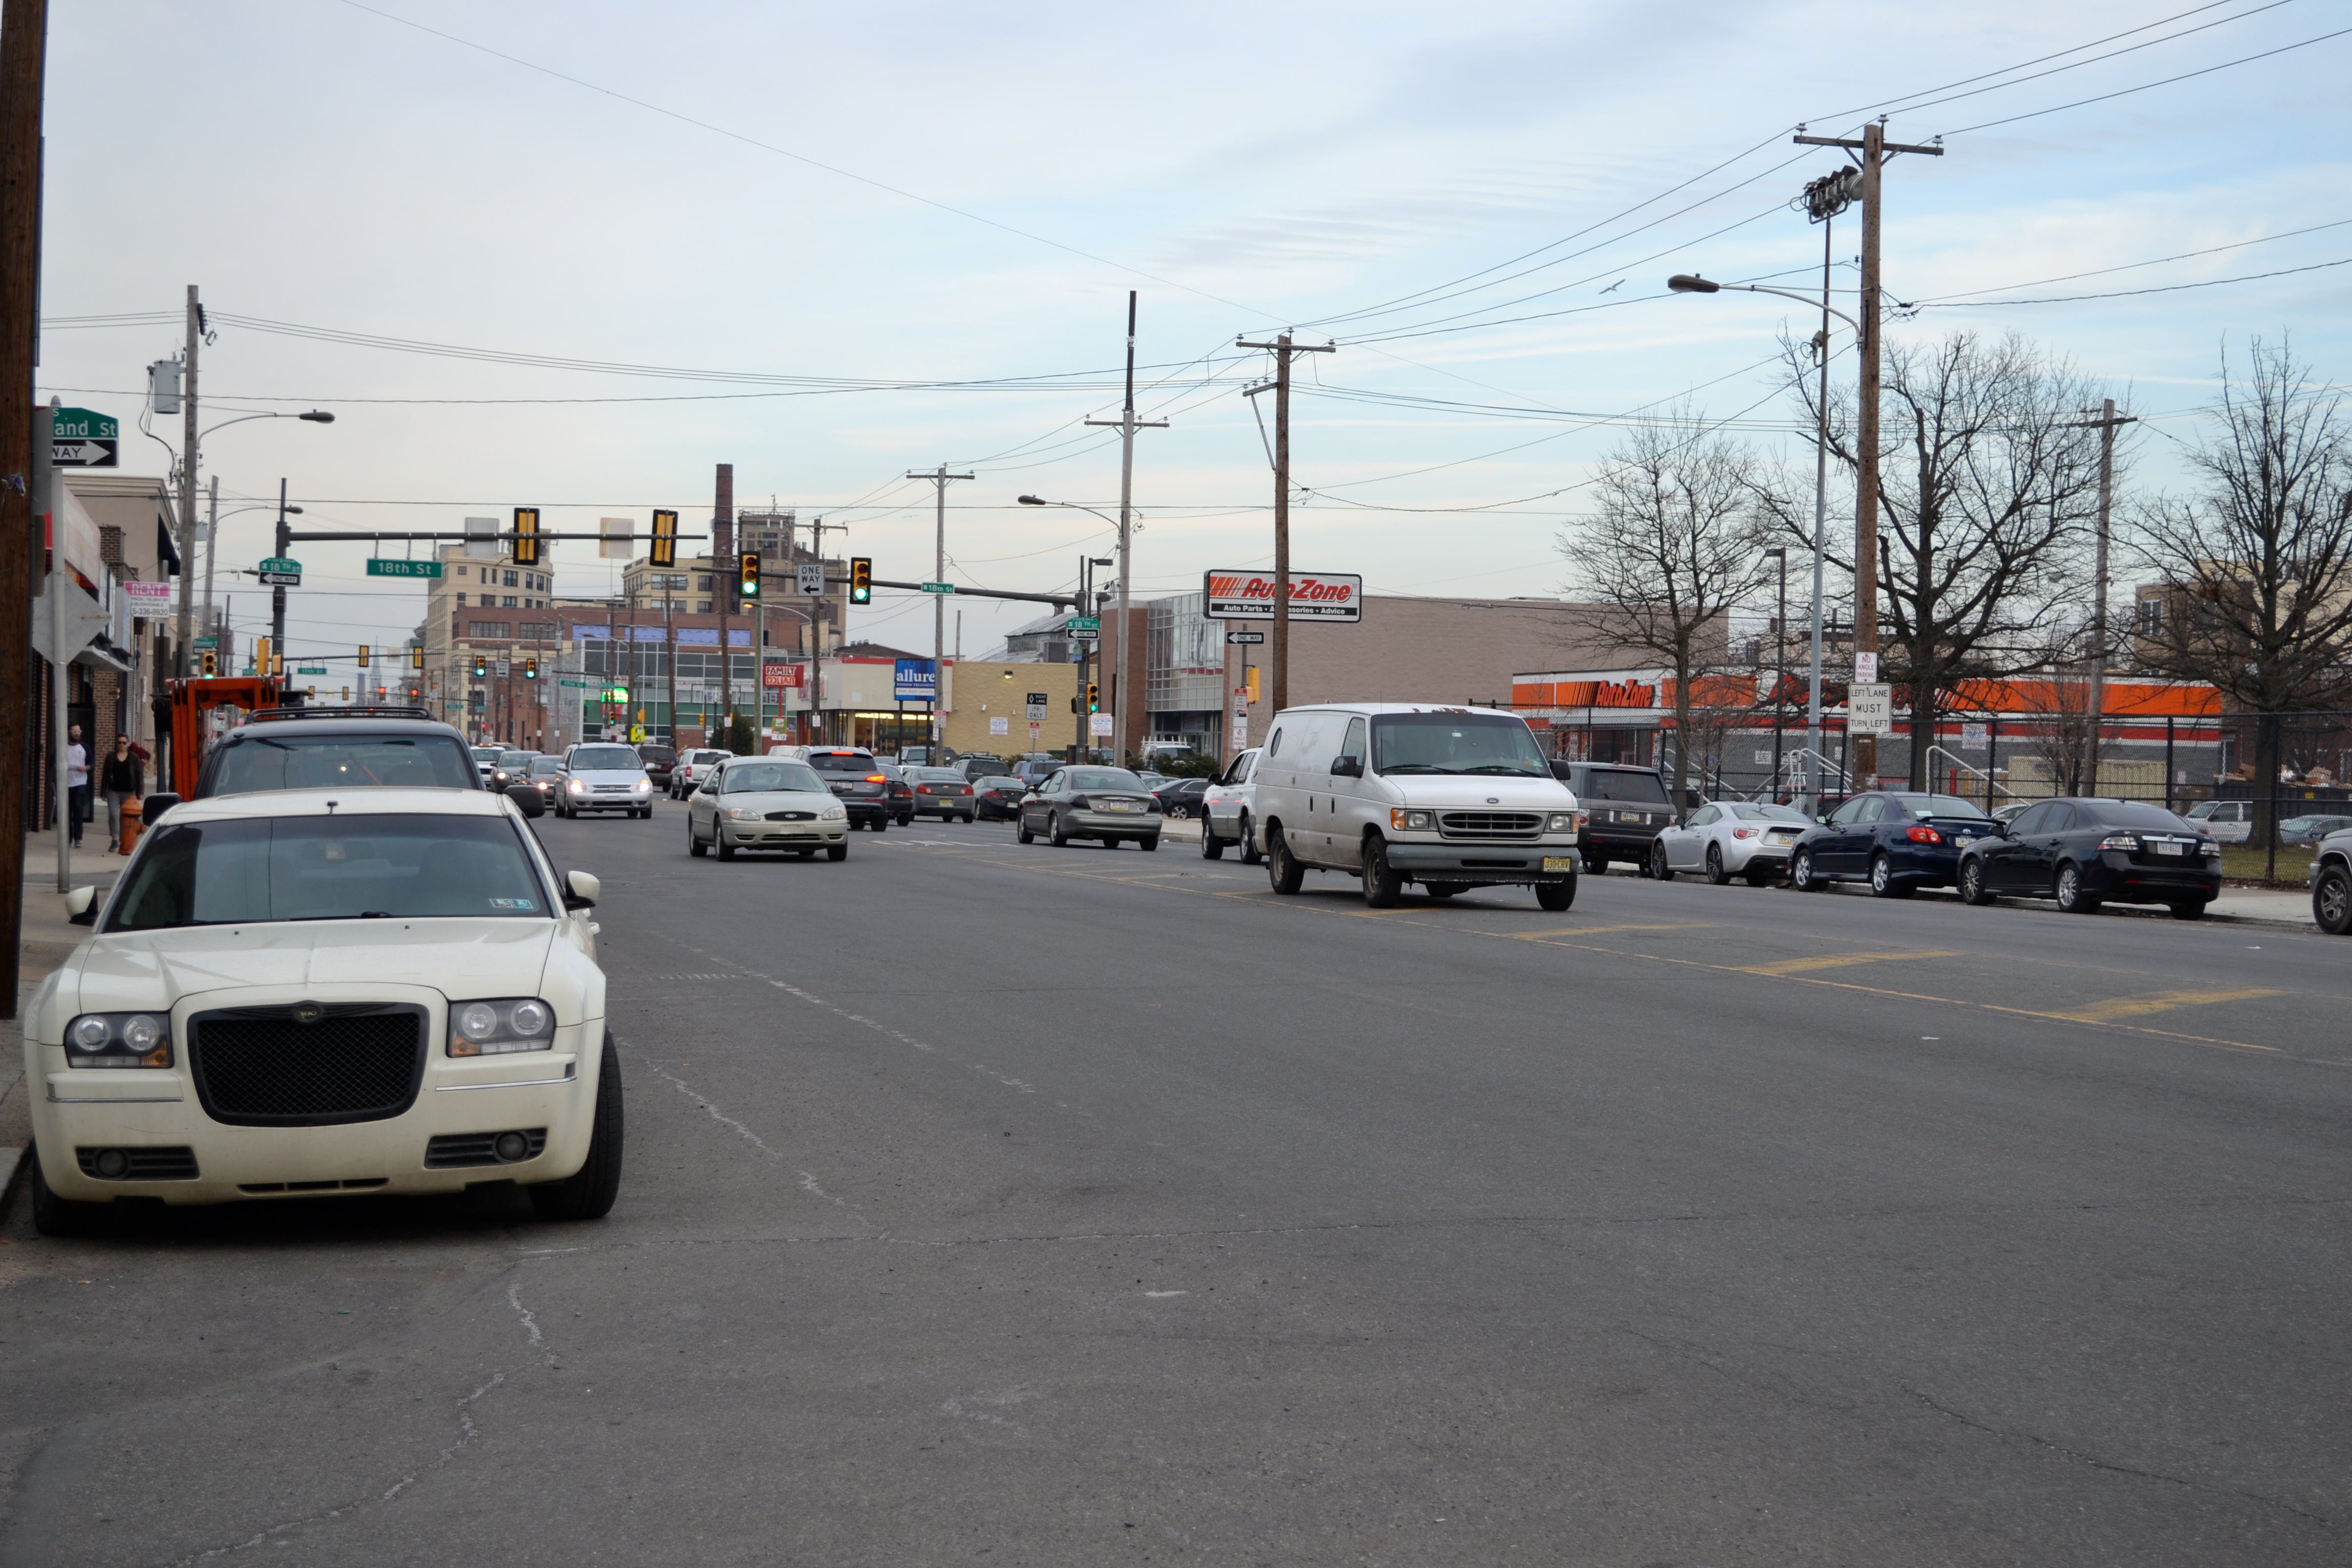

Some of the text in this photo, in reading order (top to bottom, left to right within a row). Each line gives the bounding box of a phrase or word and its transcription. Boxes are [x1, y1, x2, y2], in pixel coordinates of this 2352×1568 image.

[55, 420, 116, 436] and St
[271, 562, 280, 571] 18
[378, 562, 431, 575] 18th St
[802, 566, 820, 574] ONE
[132, 583, 163, 595] RENT
[133, 607, 168, 616] 5-336-8920
[766, 666, 796, 676] FAMILY
[896, 669, 935, 682] allure
[766, 676, 795, 685] DOLLAR
[1595, 680, 1653, 707] AutoZone
[1856, 703, 1881, 713] MUST
[1851, 719, 1867, 727] TURN
